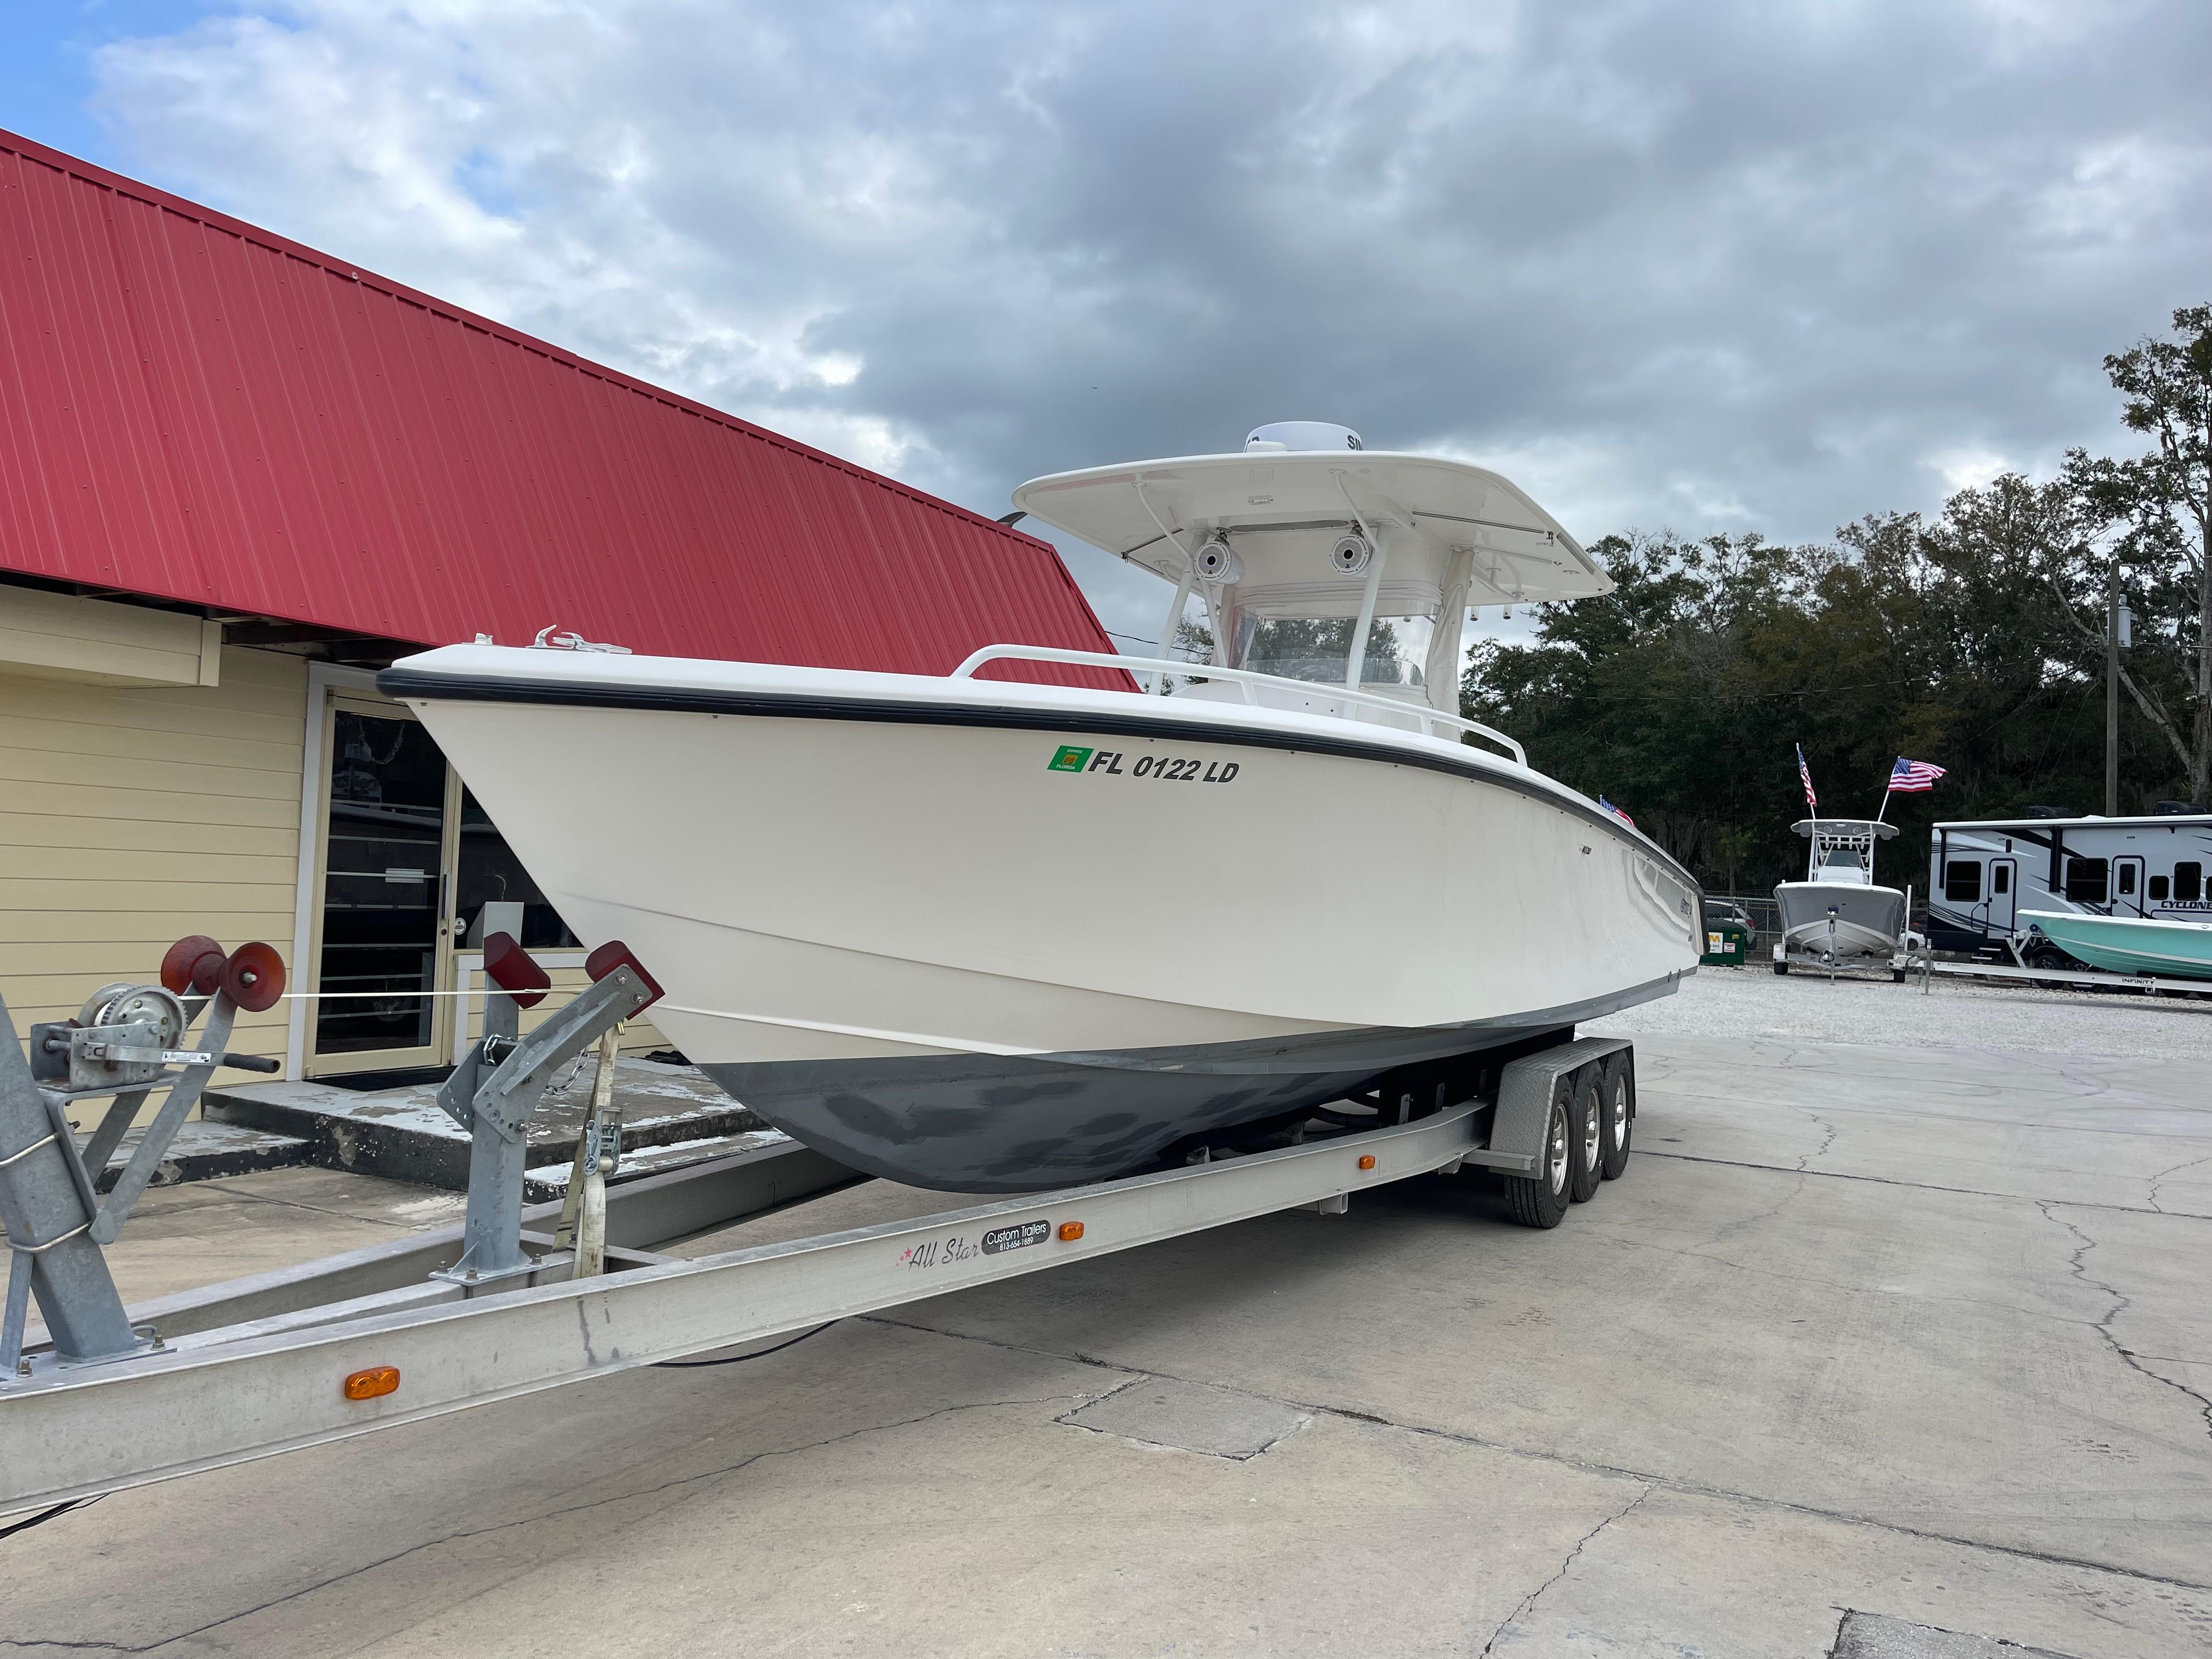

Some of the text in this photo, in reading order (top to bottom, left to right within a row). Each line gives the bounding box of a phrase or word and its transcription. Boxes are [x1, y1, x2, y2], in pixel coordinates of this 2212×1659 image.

[1088, 751, 1239, 783] FL 0122 LD
[987, 1223, 1046, 1245] Custom Trailers
[1000, 1236, 1034, 1251] 813-654-1889
[909, 1237, 979, 1272] All Star
